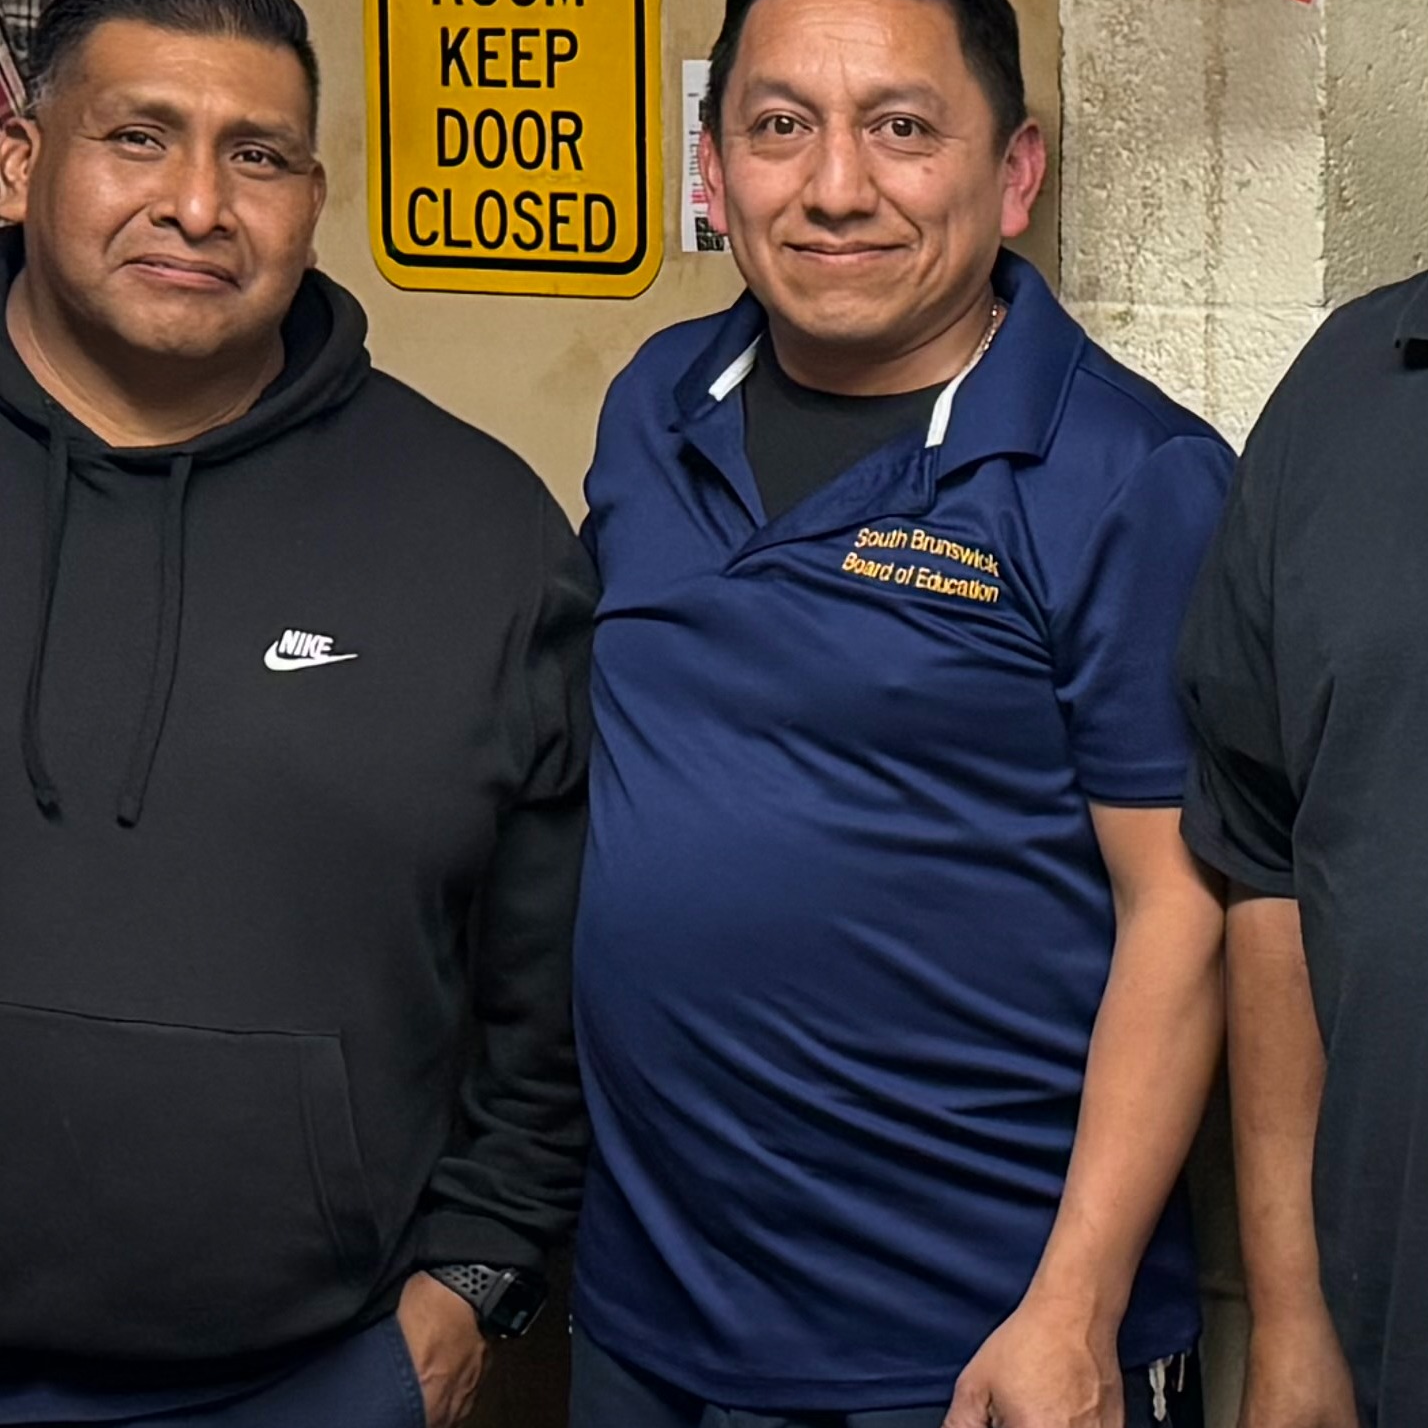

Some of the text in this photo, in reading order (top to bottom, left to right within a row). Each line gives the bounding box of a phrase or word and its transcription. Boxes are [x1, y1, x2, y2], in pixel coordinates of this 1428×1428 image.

[440, 27, 578, 88] KEEP
[436, 107, 584, 171] DOOR
[408, 187, 617, 253] CLOSED
[841, 552, 1000, 603] Board of Education
[854, 527, 1000, 578] South Brunswick
[278, 629, 334, 659] NIKE
